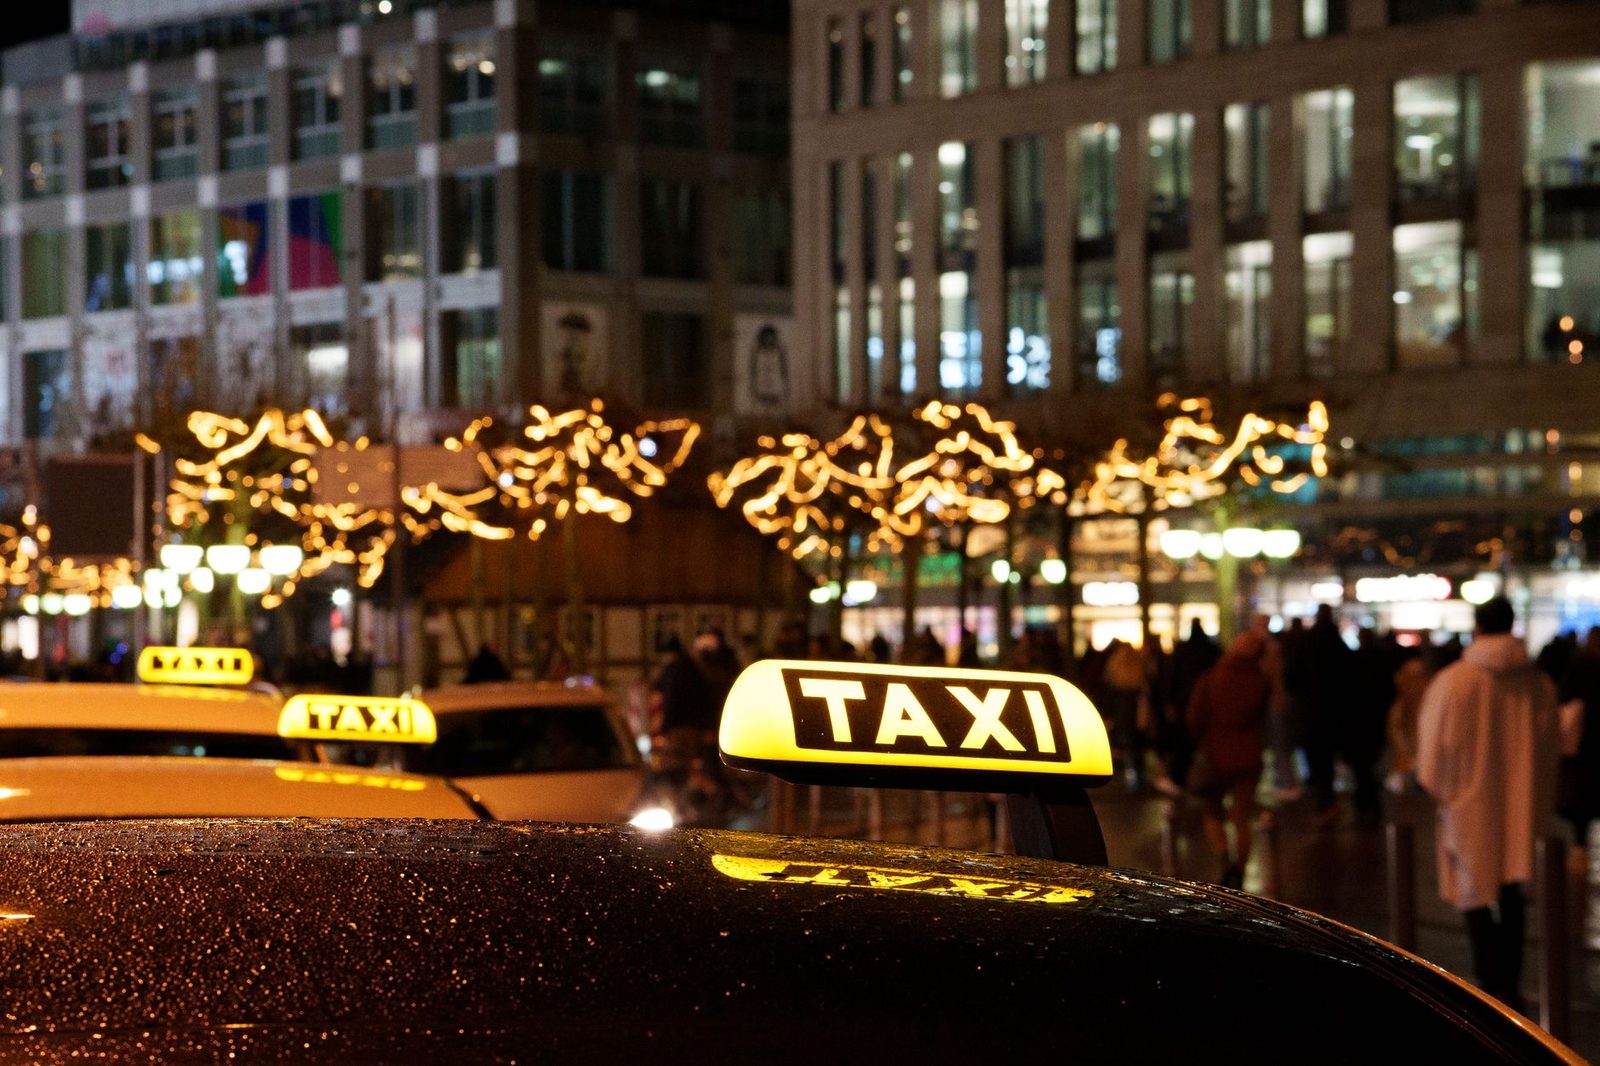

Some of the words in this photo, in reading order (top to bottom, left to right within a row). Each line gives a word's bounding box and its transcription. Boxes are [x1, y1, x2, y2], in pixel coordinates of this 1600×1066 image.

[154, 655, 237, 671] TAXI
[309, 703, 412, 733] TAXI
[799, 678, 1056, 753] TAXI
